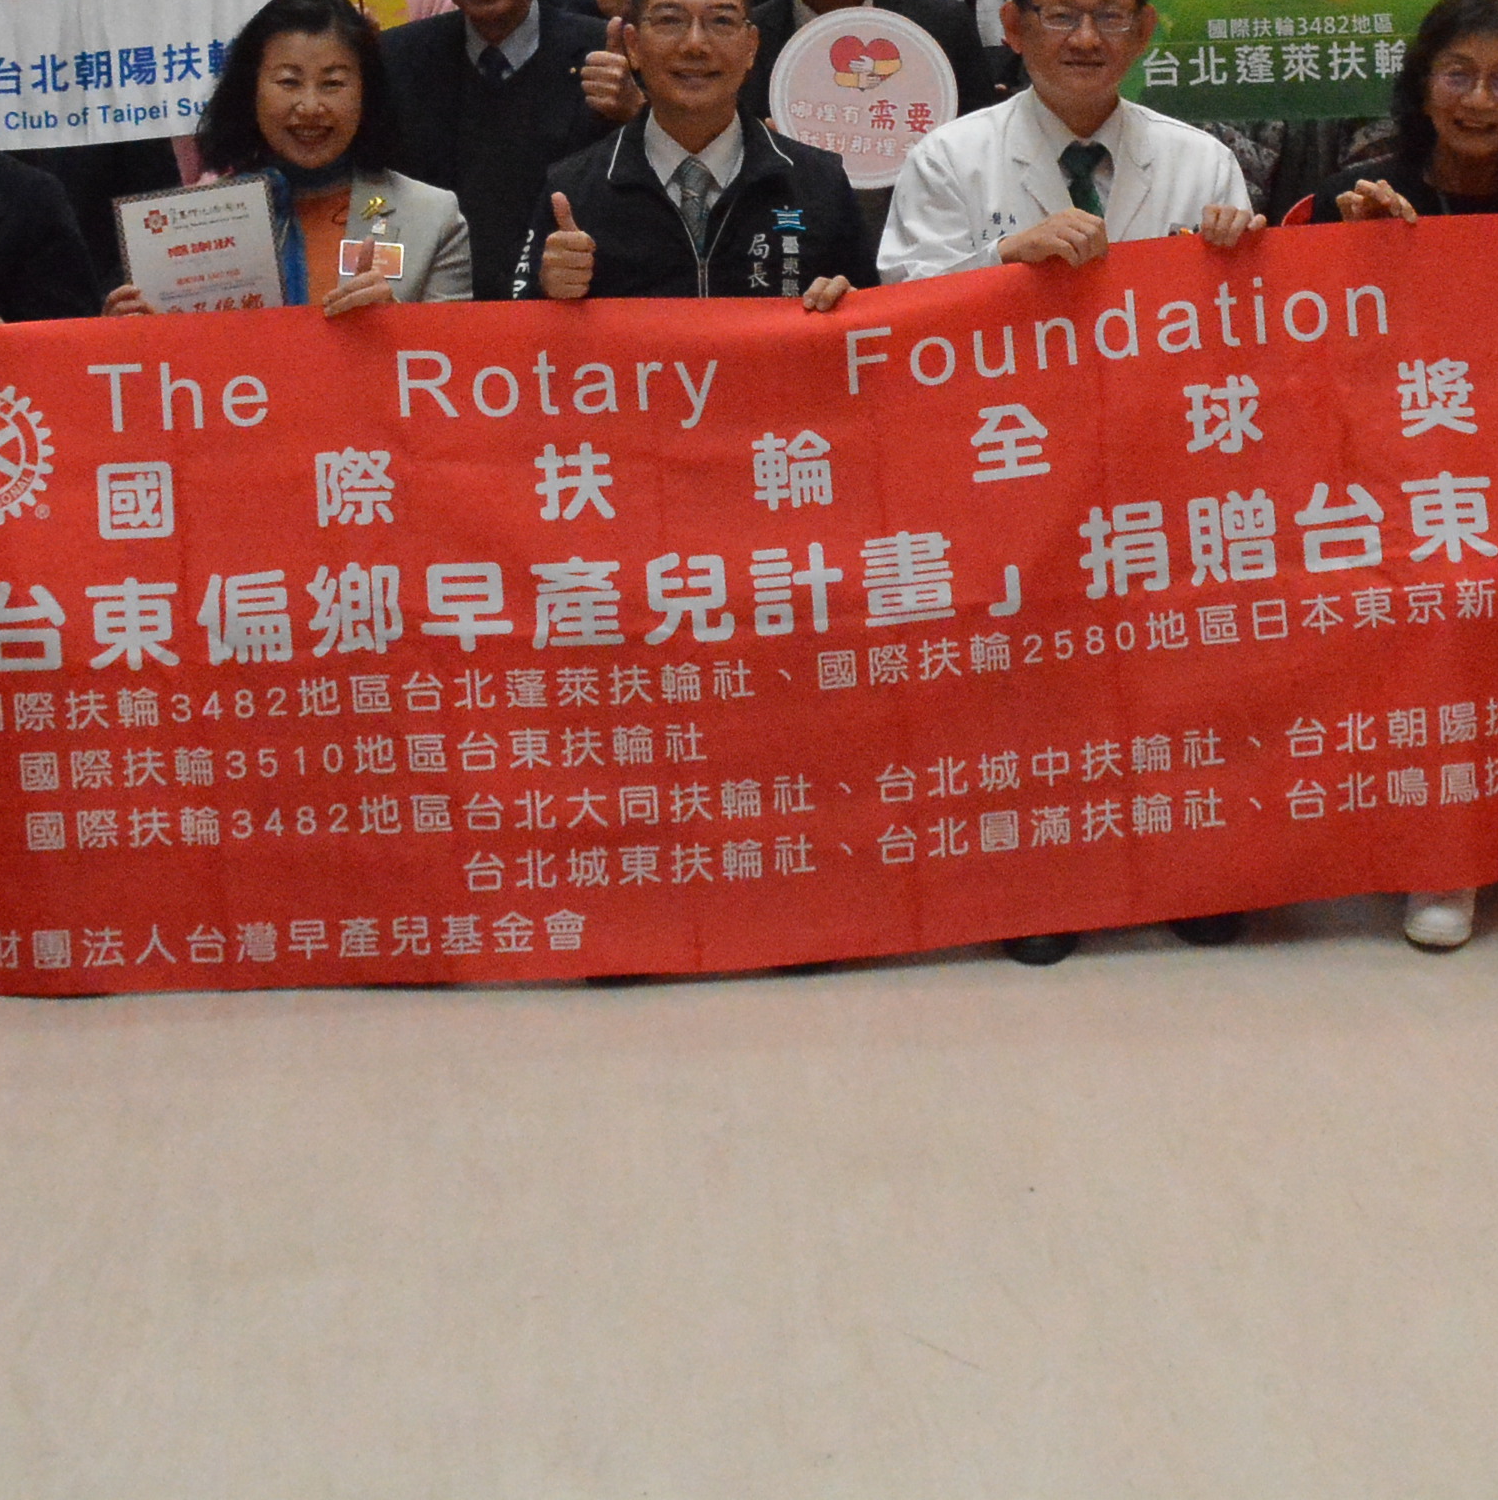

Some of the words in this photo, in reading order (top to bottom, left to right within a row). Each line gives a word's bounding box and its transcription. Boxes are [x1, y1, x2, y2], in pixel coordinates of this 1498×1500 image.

[1207, 13, 1394, 40] 國際扶輪3482地區
[1143, 39, 1407, 87] 台北蓬萊扶輪
[4, 106, 58, 132] Club
[67, 106, 89, 127] of
[99, 100, 169, 126] Taipei
[747, 233, 770, 288] 局長
[87, 361, 269, 433] The
[396, 349, 718, 429] Rotary
[845, 276, 1389, 395] Foundation
